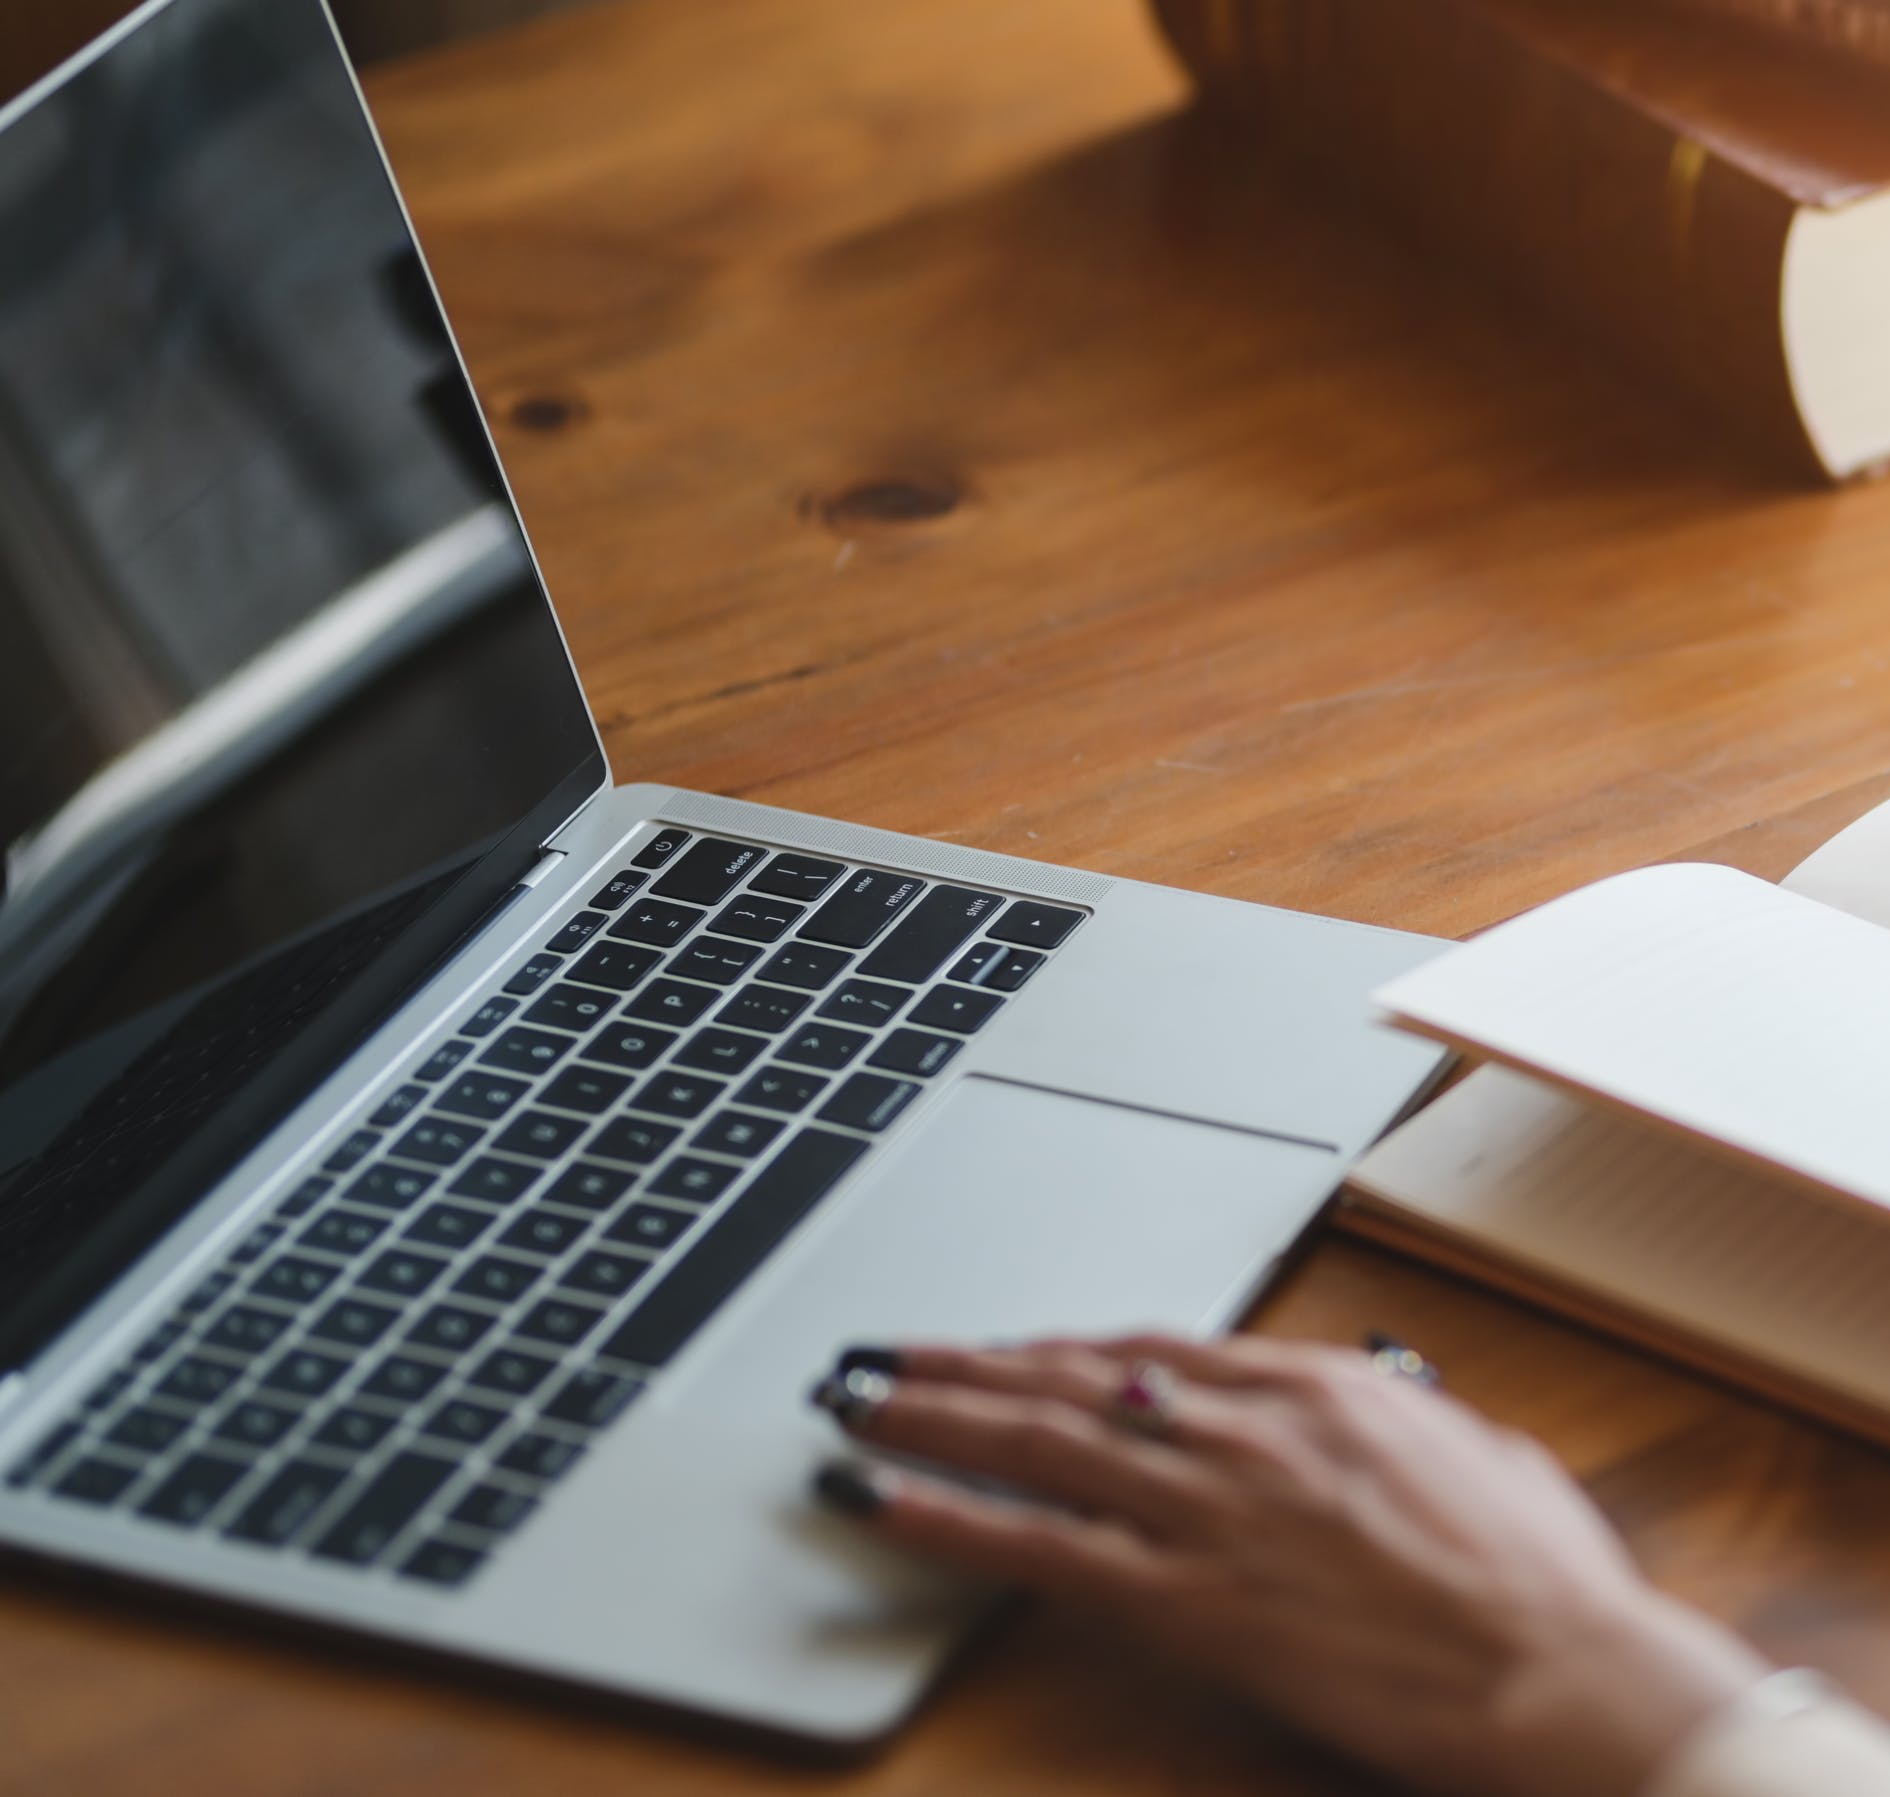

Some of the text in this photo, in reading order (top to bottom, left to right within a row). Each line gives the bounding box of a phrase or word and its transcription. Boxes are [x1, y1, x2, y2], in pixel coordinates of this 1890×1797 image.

[726, 851, 753, 874] delete
[854, 875, 874, 893] enter
[885, 883, 914, 908] return
[966, 898, 990, 918] shift
[664, 995, 684, 1007] P
